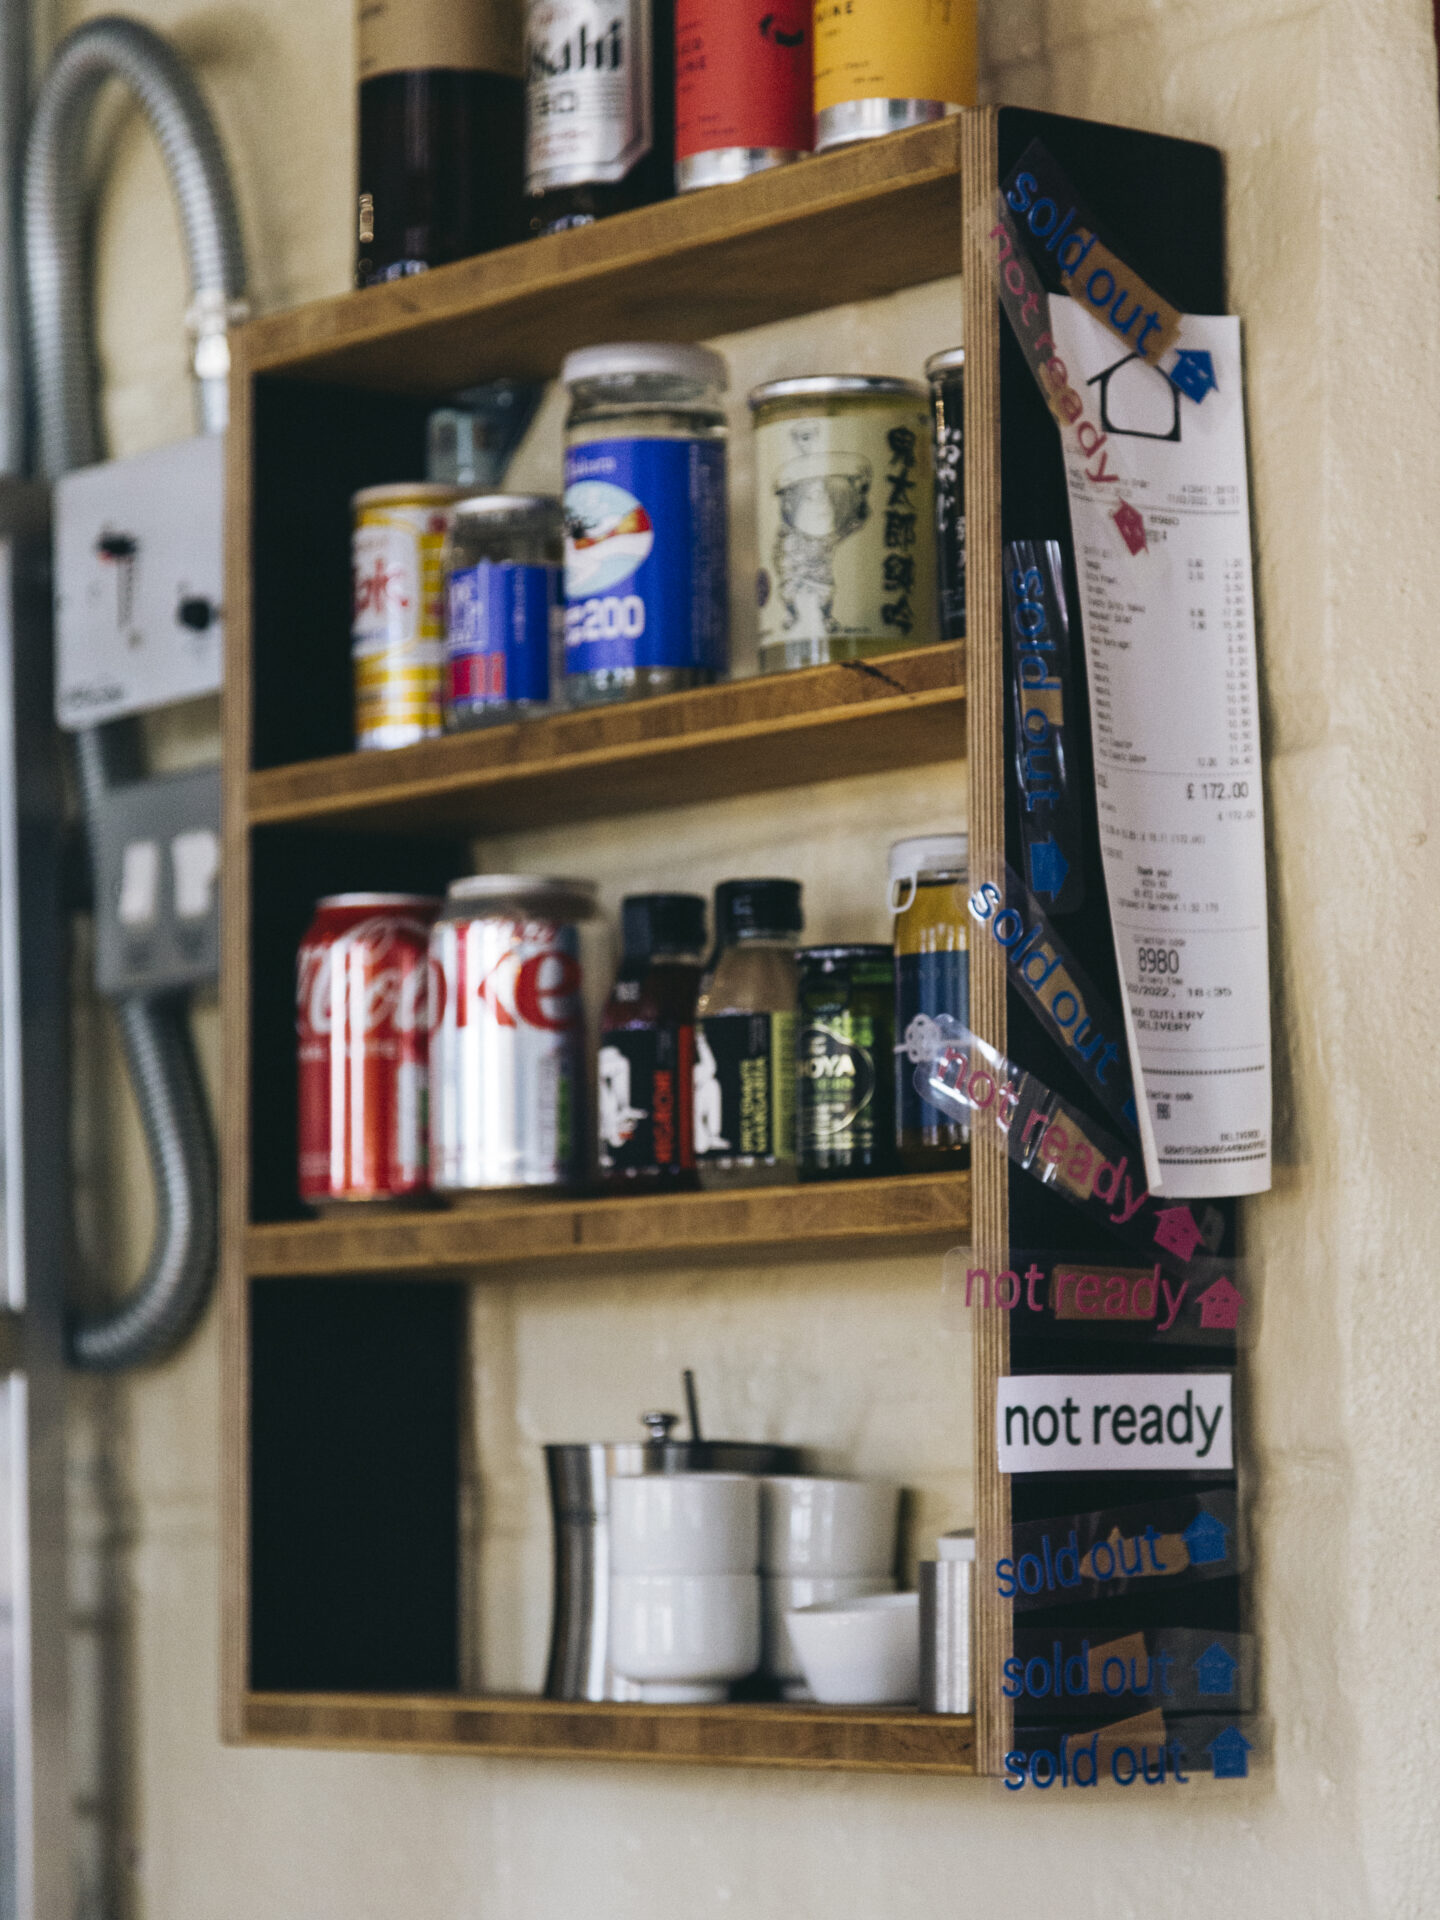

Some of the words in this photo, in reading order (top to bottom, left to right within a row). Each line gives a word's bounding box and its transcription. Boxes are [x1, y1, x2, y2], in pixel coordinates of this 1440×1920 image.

[1006, 172, 1097, 278] sold
[1086, 268, 1163, 357] out
[990, 223, 1040, 327] not
[1034, 331, 1119, 483] ready
[1012, 567, 1062, 690] sold
[1022, 708, 1060, 812] out
[1186, 783, 1195, 800] £
[1202, 781, 1249, 800] 172.00
[968, 880, 1063, 992] sold
[1051, 989, 1119, 1085] out
[1138, 946, 1180, 974] 8980
[1137, 1019, 1192, 1032] DELIVERY
[936, 1047, 1020, 1132] not
[1021, 1108, 1150, 1224] ready
[965, 1264, 1045, 1311] not
[1055, 1264, 1189, 1330] ready
[1005, 1397, 1082, 1445] not
[1093, 1389, 1224, 1457] ready
[996, 1530, 1082, 1598] sold
[1091, 1525, 1168, 1581] out
[1002, 1640, 1091, 1698] sold
[1102, 1651, 1175, 1697] out
[1003, 1732, 1100, 1791] sold
[1111, 1737, 1190, 1786] out
